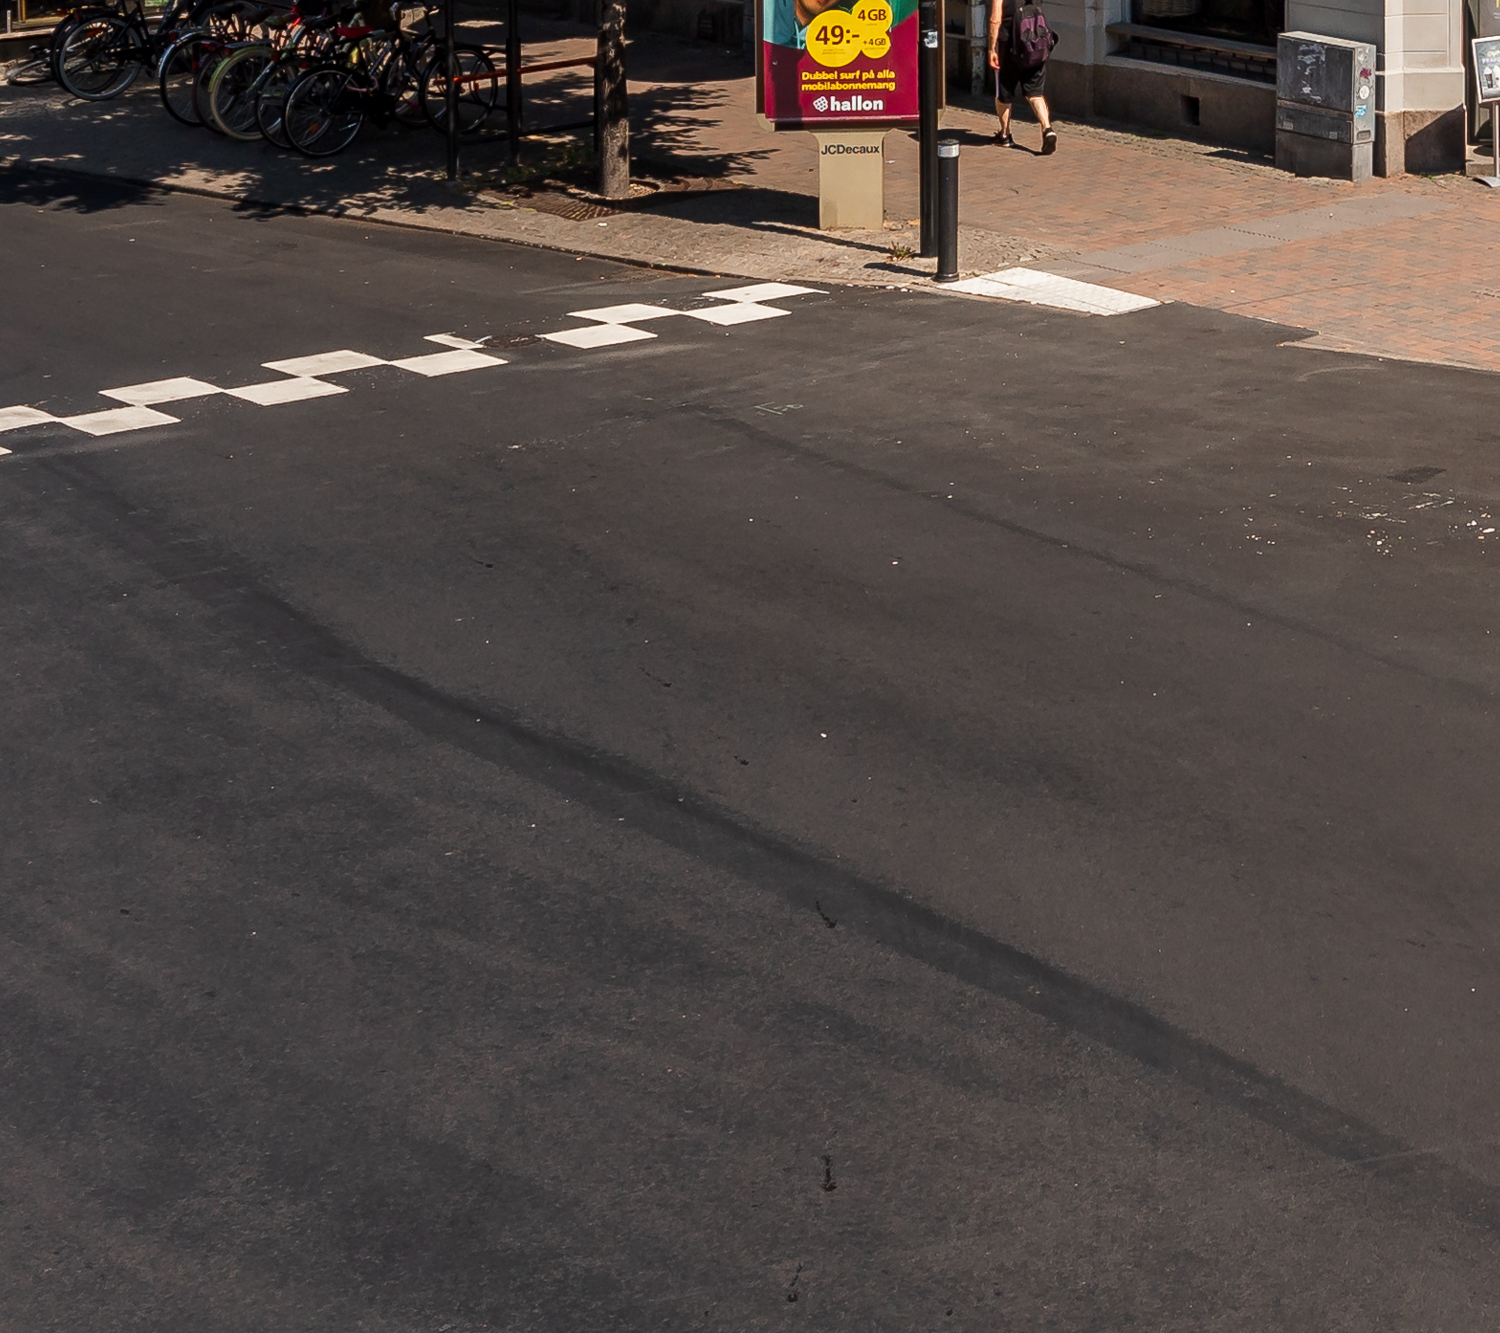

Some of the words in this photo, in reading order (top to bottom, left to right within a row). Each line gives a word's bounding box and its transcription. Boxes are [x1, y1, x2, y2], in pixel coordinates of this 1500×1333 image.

[815, 25, 860, 46] 49:-
[801, 70, 838, 81] Dubbel
[840, 70, 860, 80] surf
[862, 69, 875, 81] på
[877, 69, 896, 79] alla
[801, 81, 896, 92] mobilabonnemang
[830, 95, 884, 111] hallon
[821, 144, 880, 155] JCDecaux
